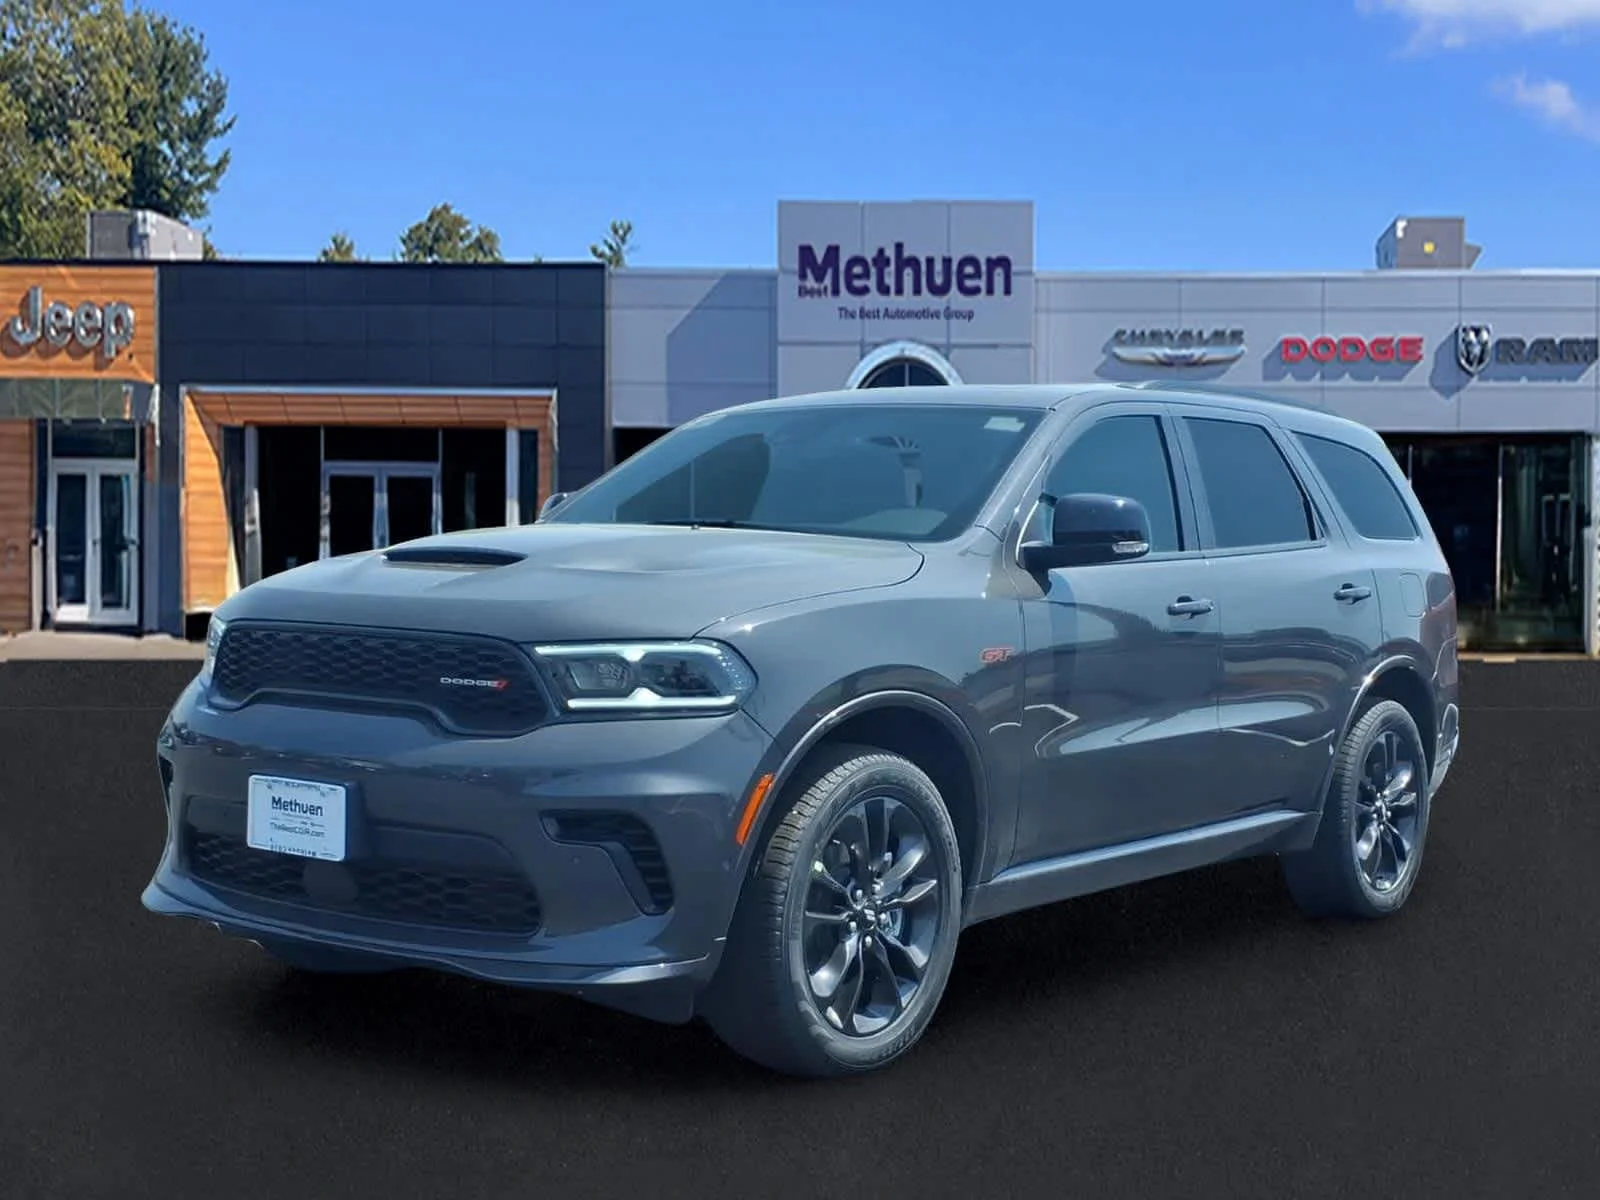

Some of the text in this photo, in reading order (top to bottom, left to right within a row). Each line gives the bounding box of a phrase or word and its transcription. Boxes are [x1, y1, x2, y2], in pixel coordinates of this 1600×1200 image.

[797, 241, 1012, 296] Methuen
[9, 286, 135, 358] Jeep
[838, 306, 974, 322] The Best Automotive Group
[1281, 335, 1424, 362] DODGE
[1495, 337, 1598, 365] RAM
[980, 647, 1014, 663] GT
[440, 677, 499, 688] DODGE
[271, 796, 324, 816] Methuen
